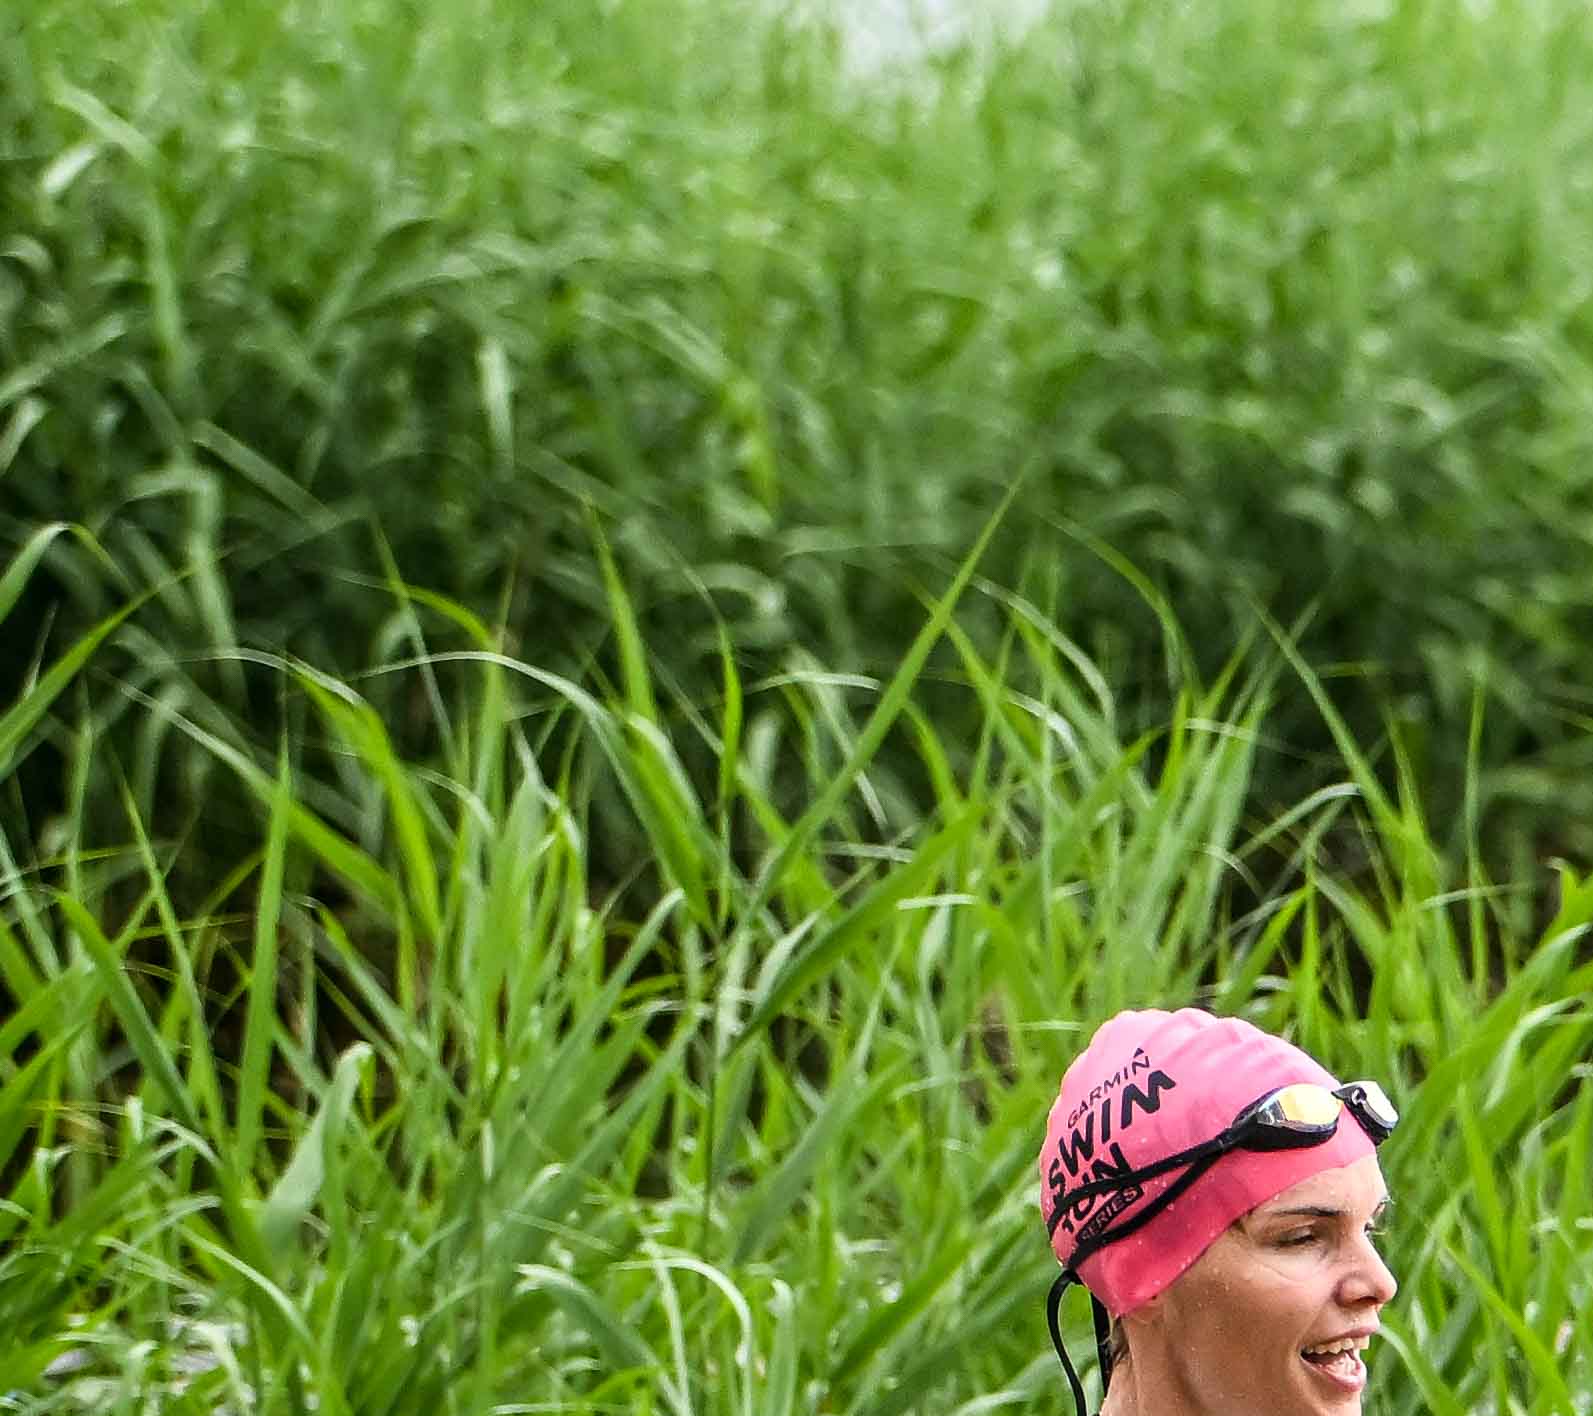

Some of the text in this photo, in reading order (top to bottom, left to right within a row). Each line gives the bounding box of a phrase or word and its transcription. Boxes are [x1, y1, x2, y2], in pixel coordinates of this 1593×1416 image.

[1067, 1047, 1150, 1129] GARMIN
[1048, 1069, 1177, 1190] SWIM
[1080, 1186, 1139, 1242] SERIES
